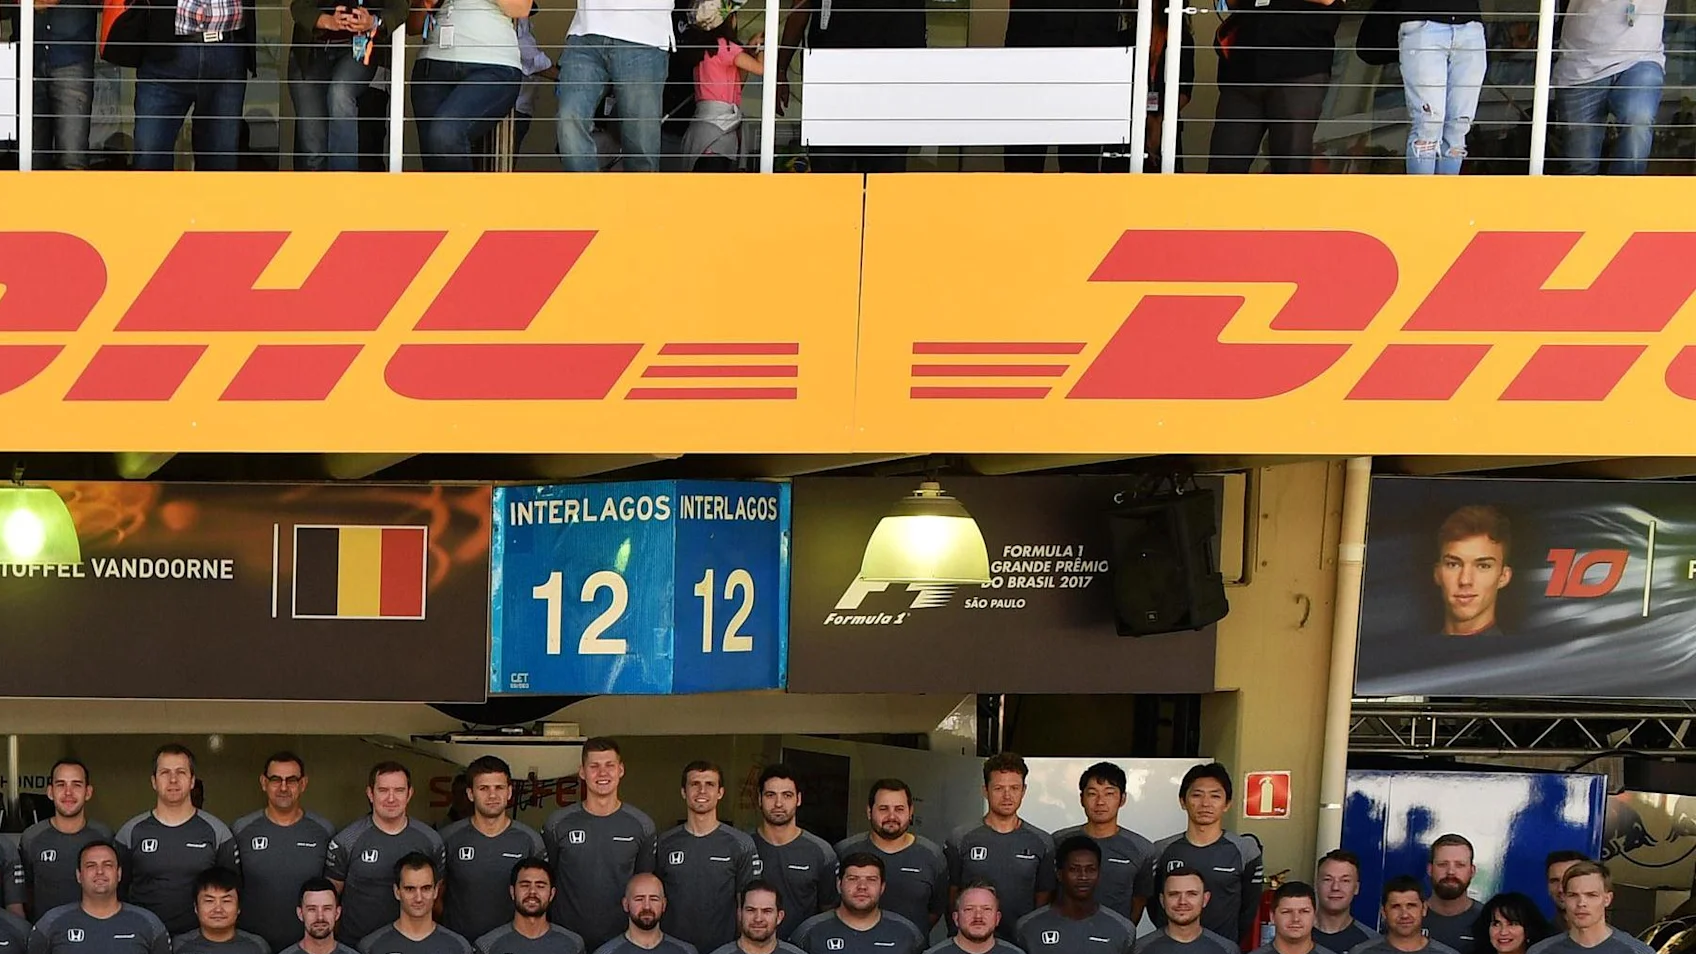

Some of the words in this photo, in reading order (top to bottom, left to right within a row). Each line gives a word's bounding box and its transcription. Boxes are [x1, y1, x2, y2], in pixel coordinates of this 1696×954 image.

[1065, 229, 1696, 401] DH
[510, 495, 672, 526] INTERLAGOS
[680, 494, 778, 521] INTERLAGOS
[1003, 545, 1073, 558] FORMULA
[1077, 545, 1084, 557] 1
[91, 558, 234, 580] VANDOORNE
[990, 560, 1051, 573] GRANDE
[1055, 557, 1109, 573] PRÊMIO
[1544, 548, 1630, 598] 10
[1007, 576, 1055, 589] BRASIL
[1060, 576, 1094, 589] 2017
[532, 570, 629, 655] 12
[694, 568, 755, 653] 12
[964, 596, 988, 609] SÃO
[990, 599, 1026, 609] PAULO
[823, 613, 891, 625] Formula
[510, 672, 529, 683] CET
